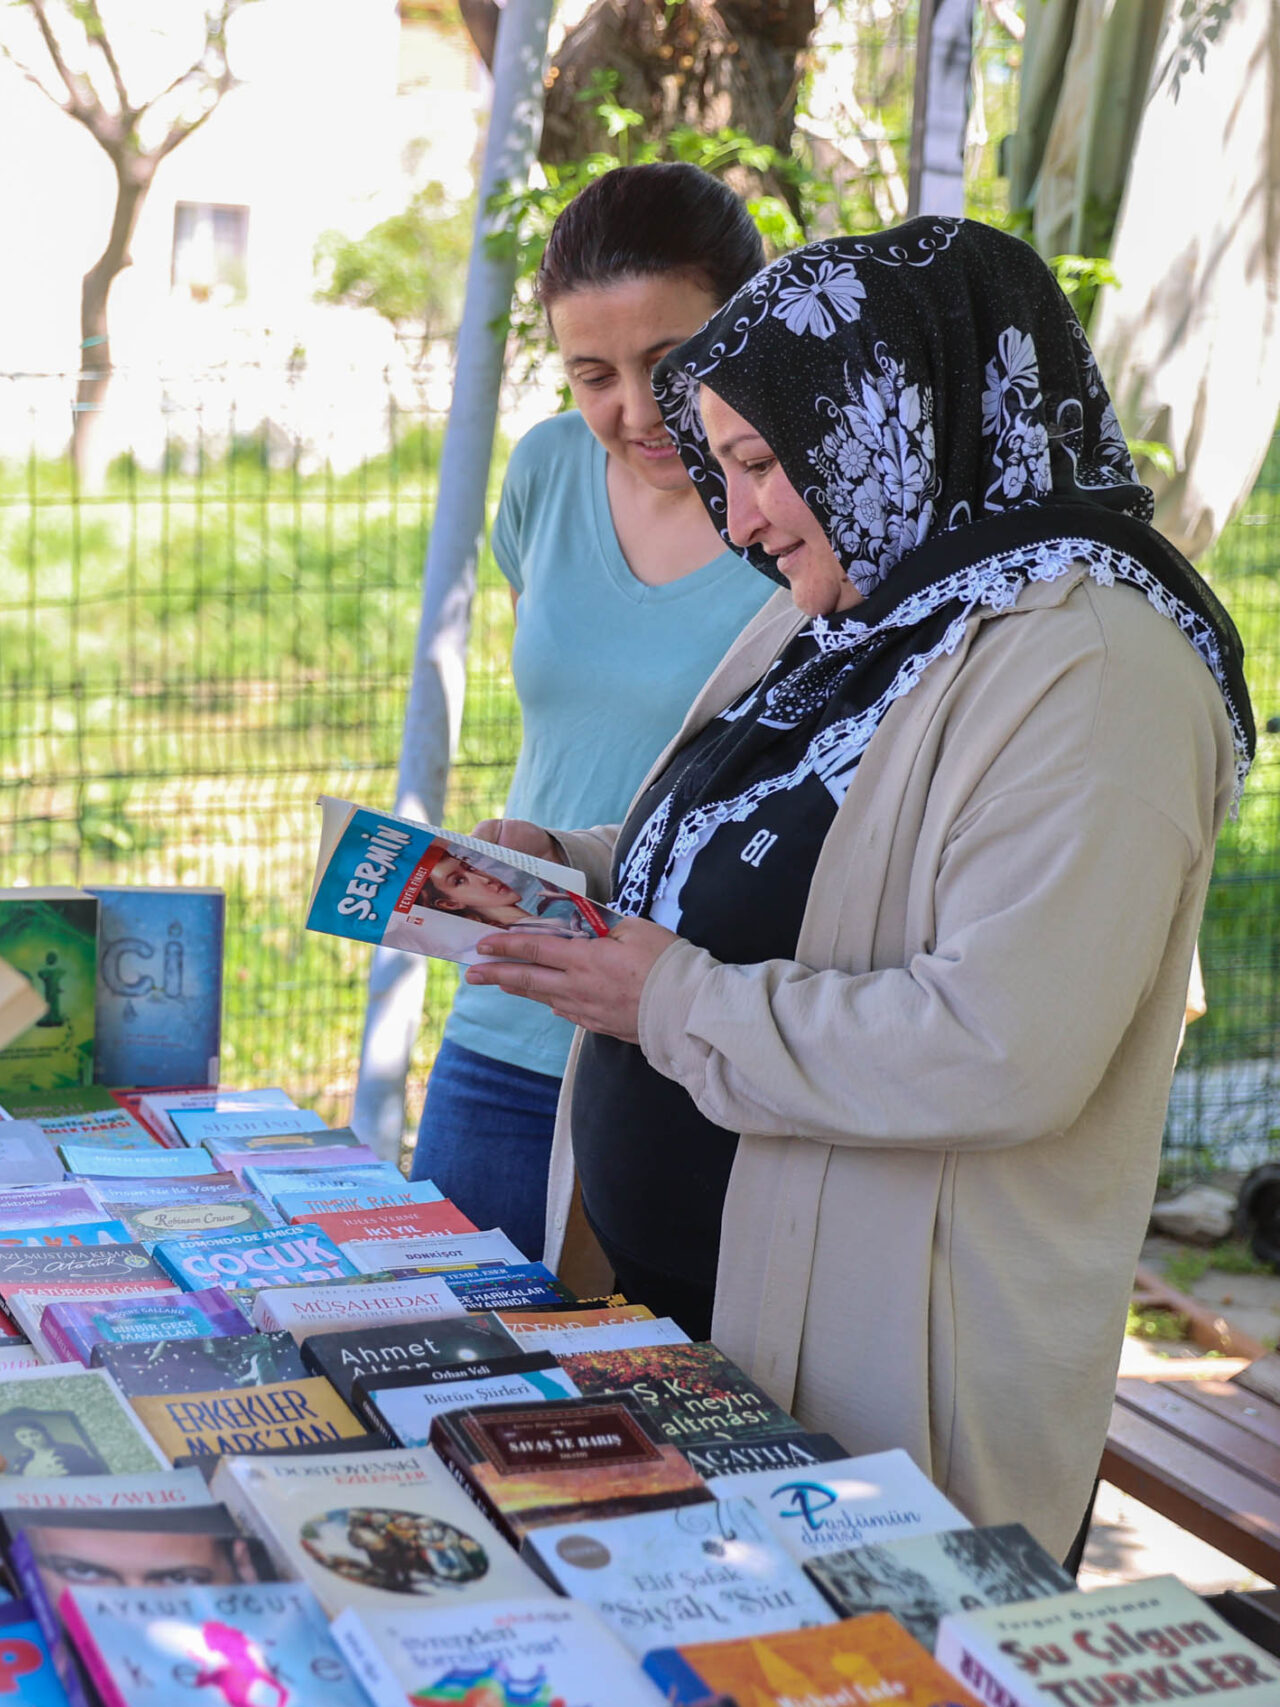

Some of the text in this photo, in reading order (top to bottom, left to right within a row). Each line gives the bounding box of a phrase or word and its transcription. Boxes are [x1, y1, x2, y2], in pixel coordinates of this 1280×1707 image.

[179, 1235, 242, 1250] EDMONDO
[244, 1233, 261, 1243] DE
[392, 1224, 422, 1236] YIL
[22, 1250, 89, 1261] MUSTAFA
[90, 1249, 133, 1259] KEMAL
[405, 1250, 464, 1260] DONKİŞOT
[292, 1293, 440, 1315] MÜŞAHEDAT
[474, 1286, 546, 1303] HARİKALAR
[341, 1337, 441, 1367] Ahmet
[431, 1364, 491, 1382] Orhan Veli
[423, 1381, 532, 1405] Bütün Şiirleri
[684, 1387, 761, 1414] neyin
[165, 1389, 319, 1433] ERKEKLER
[661, 1409, 771, 1438] altması
[508, 1433, 622, 1455] SAVAŞ VE BARIŞ
[686, 1441, 821, 1470] AGATHA
[633, 1566, 744, 1593] Elif Şafak
[1072, 1619, 1223, 1666] Çılgın
